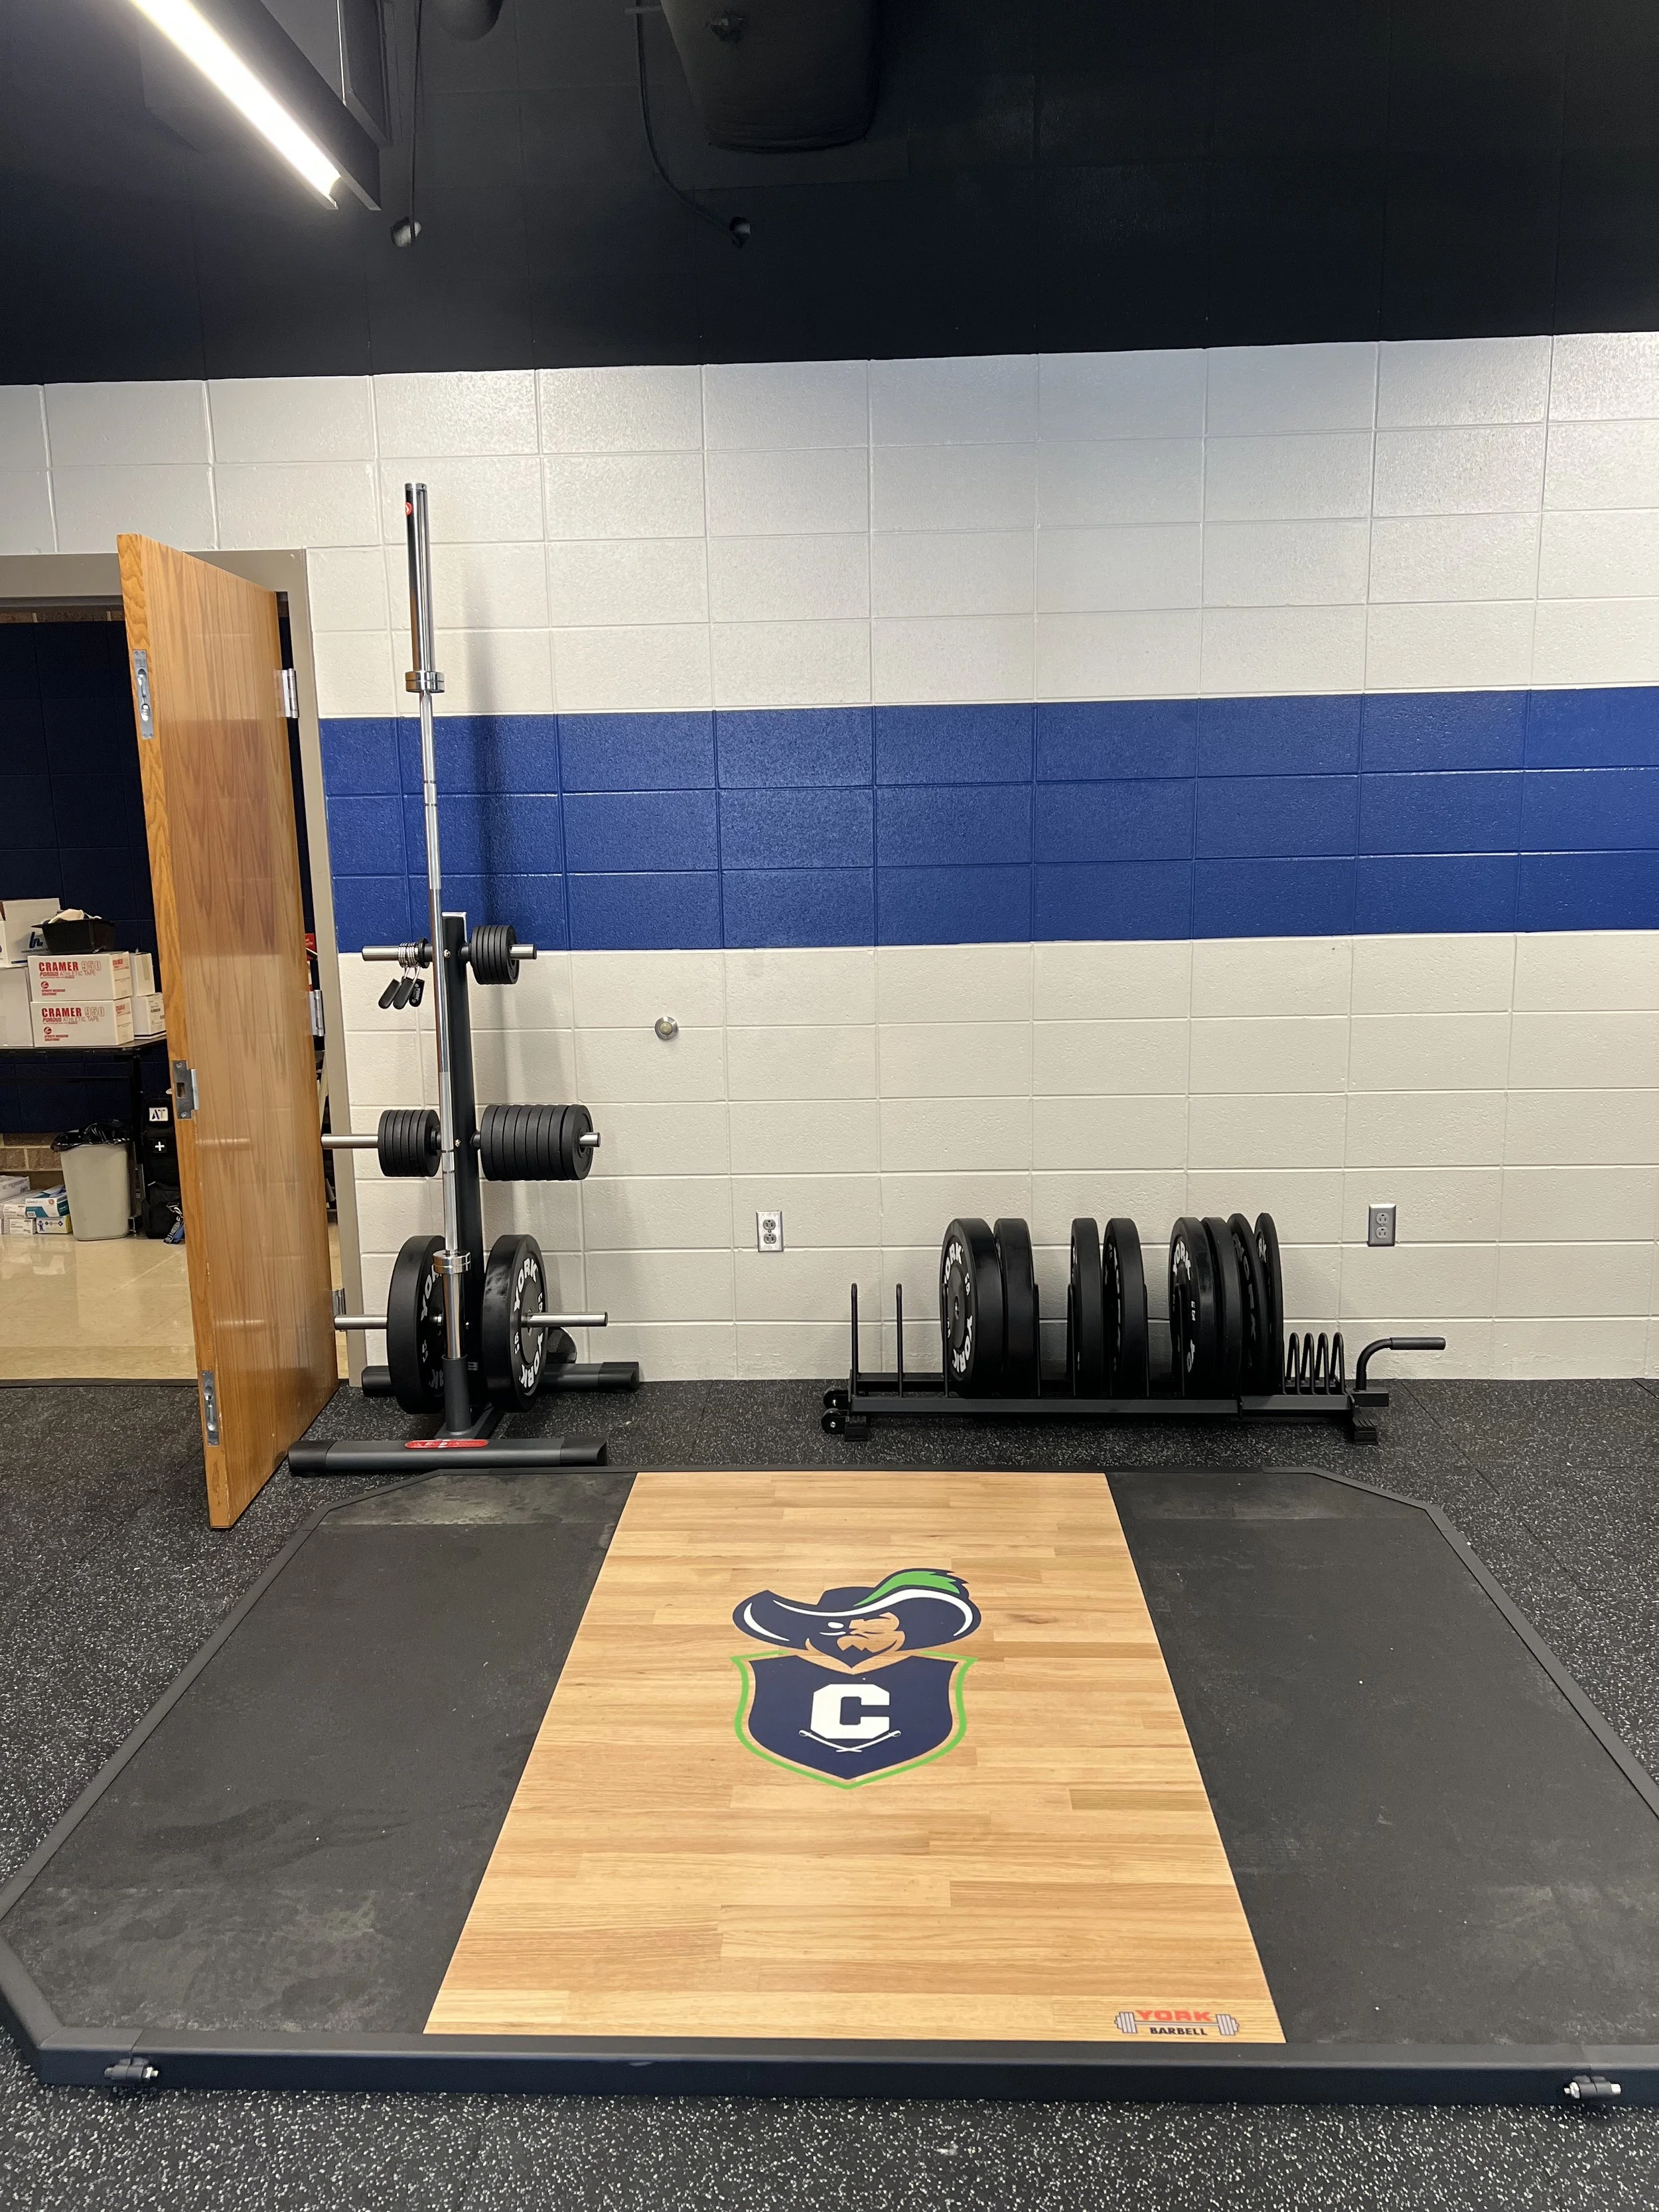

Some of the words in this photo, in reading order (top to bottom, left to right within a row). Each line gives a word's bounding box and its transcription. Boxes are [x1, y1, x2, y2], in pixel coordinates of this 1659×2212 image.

[38, 962, 79, 972] CRAMER
[80, 960, 102, 971] 950
[42, 1007, 82, 1017] CRAMER
[84, 1006, 105, 1017] 950
[151, 1109, 166, 1120] AT
[1173, 1240, 1192, 1281] YORK
[420, 1264, 443, 1321] YOR
[514, 1258, 539, 1313] YORK
[519, 1332, 544, 1389] YORK
[952, 1315, 974, 1373] YORK
[810, 1684, 890, 1739] C
[1135, 2010, 1213, 2022] YORK
[1149, 2027, 1208, 2036] BARBELL
